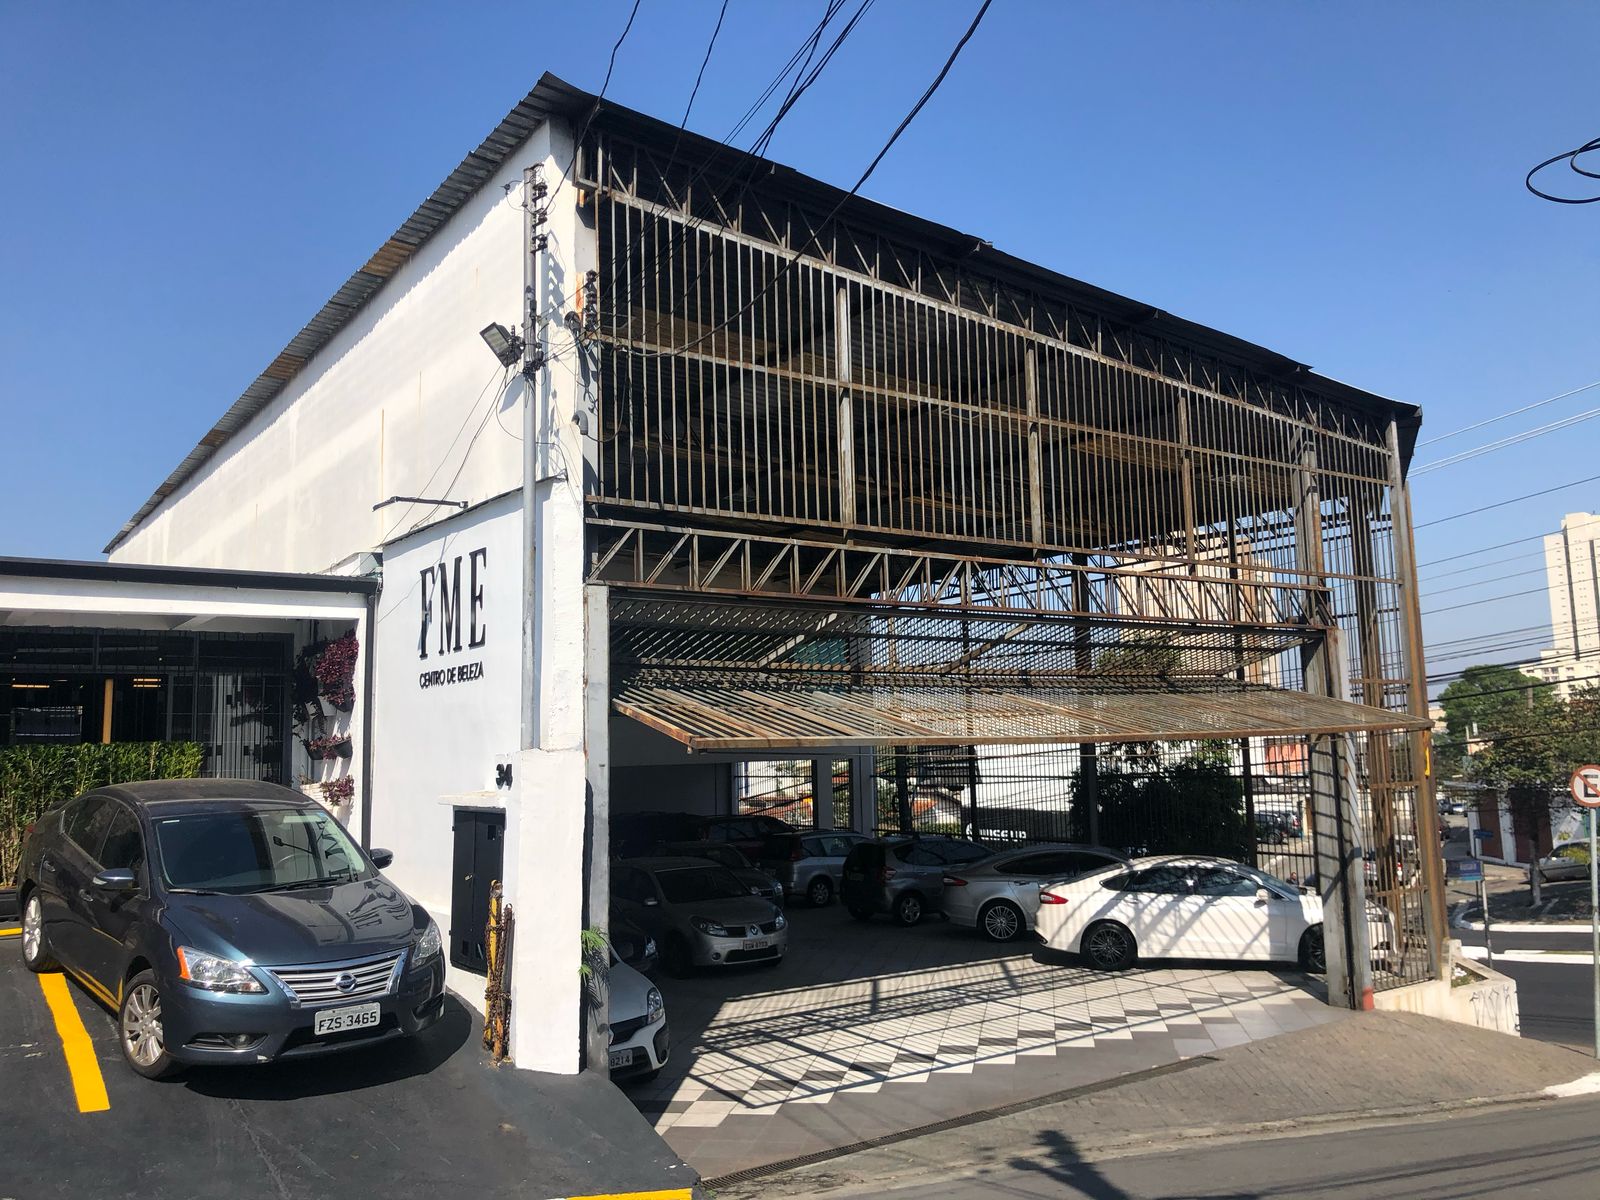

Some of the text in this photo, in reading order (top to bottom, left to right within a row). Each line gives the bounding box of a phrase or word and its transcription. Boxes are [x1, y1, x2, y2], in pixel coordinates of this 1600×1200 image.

[419, 547, 487, 660] FME
[419, 661, 484, 689] CENTRO DE BELEZA
